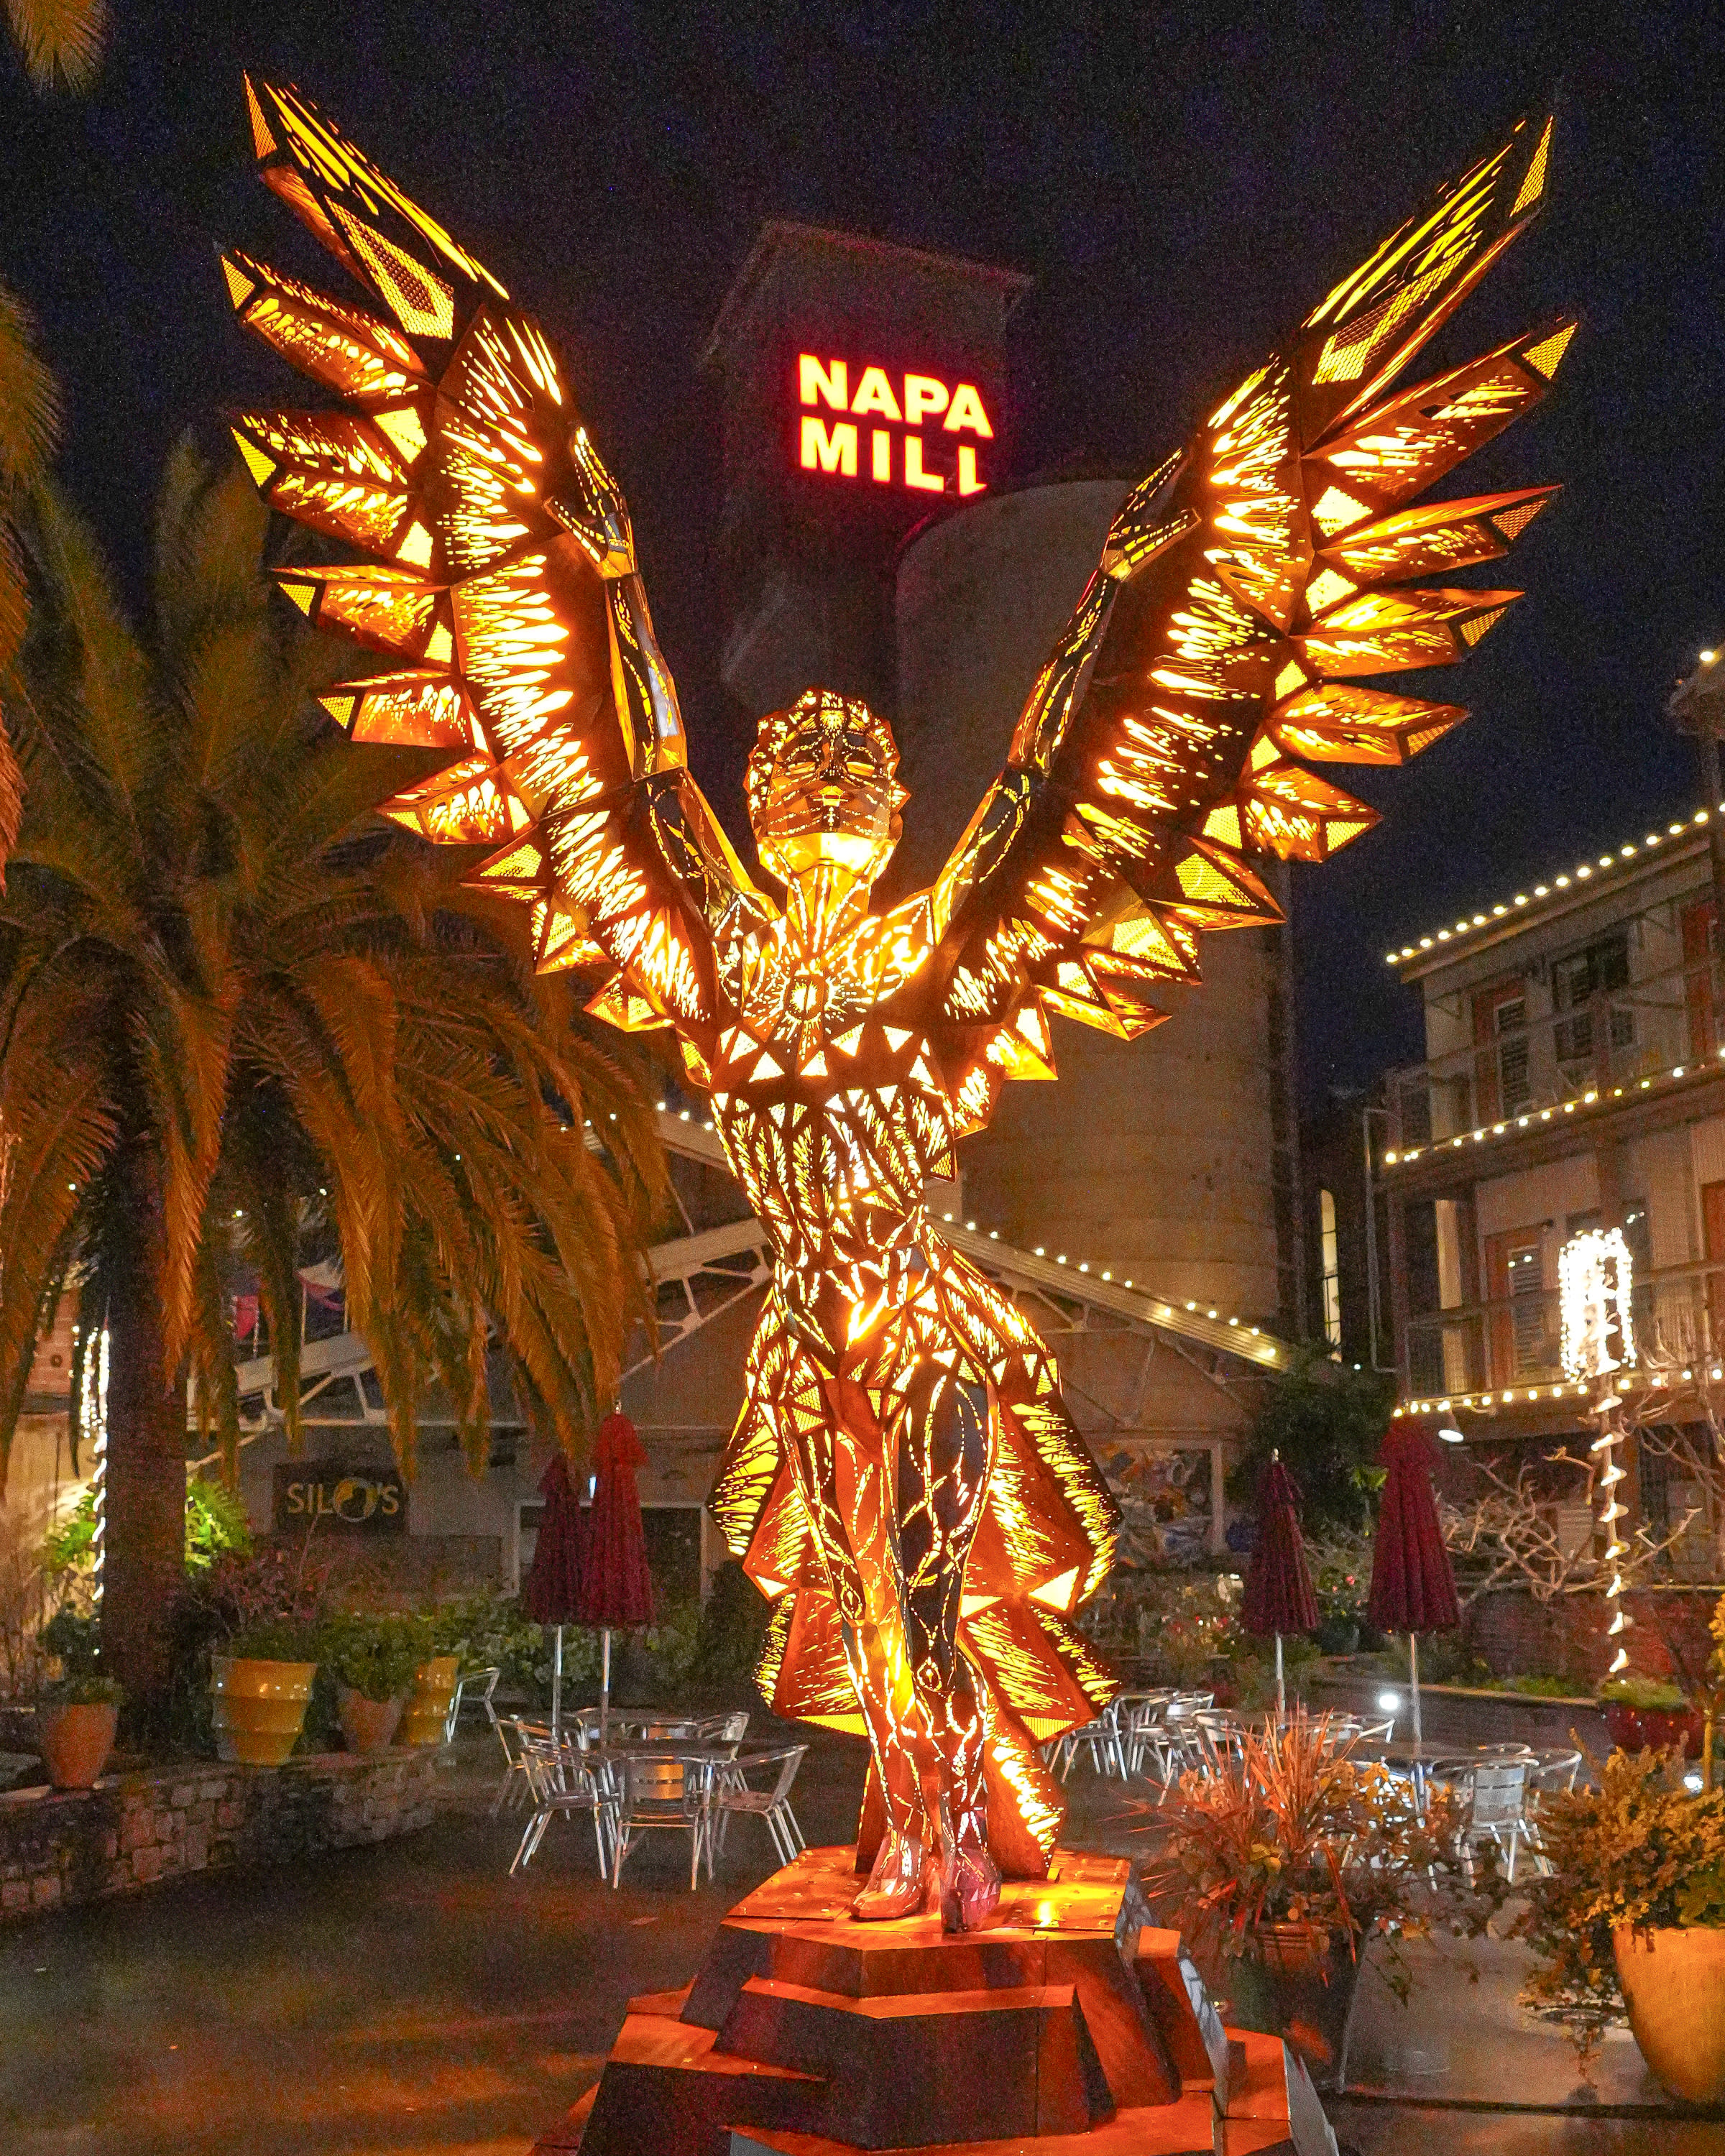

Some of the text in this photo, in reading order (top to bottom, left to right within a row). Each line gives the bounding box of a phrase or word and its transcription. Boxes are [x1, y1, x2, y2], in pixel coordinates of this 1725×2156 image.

[799, 352, 994, 439] NAPA
[799, 415, 988, 497] MILL
[288, 1476, 400, 1523] SILO'S
